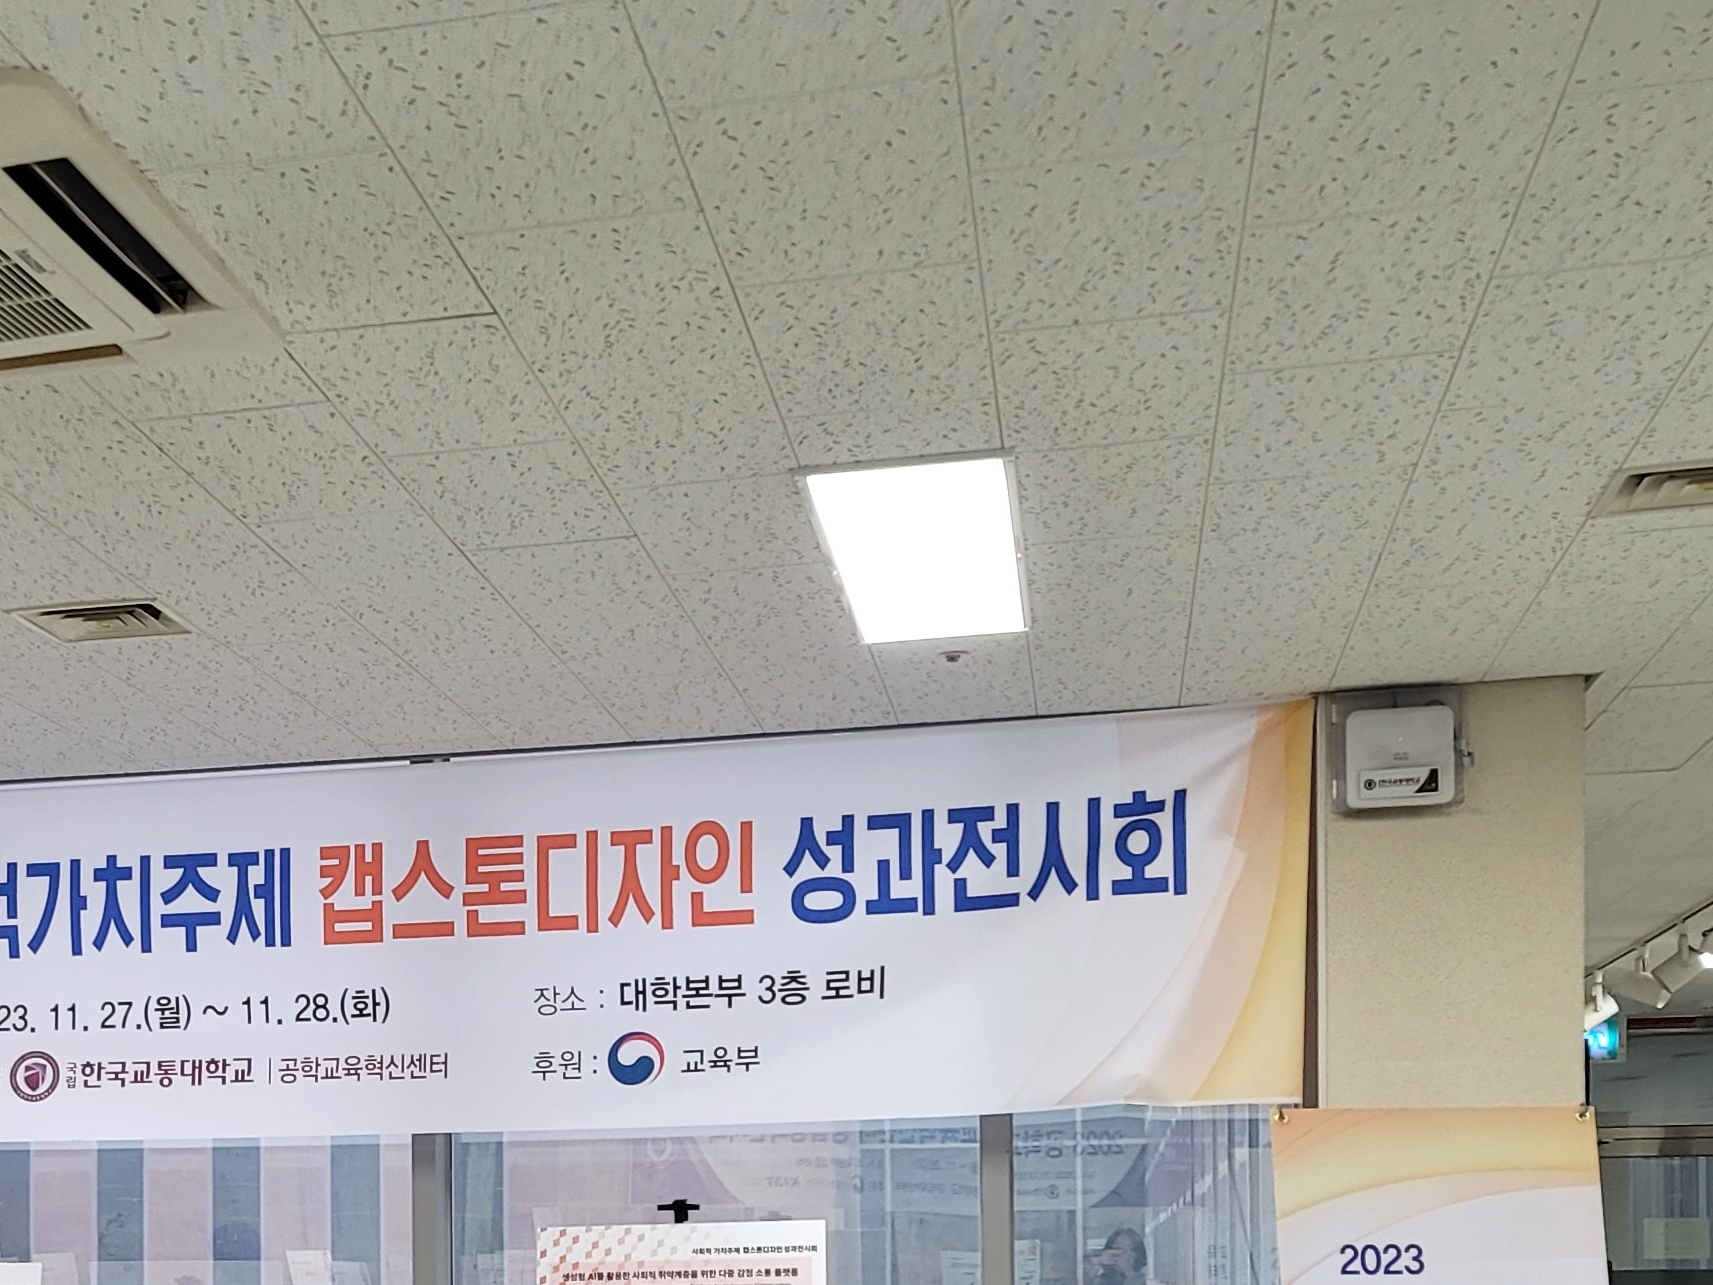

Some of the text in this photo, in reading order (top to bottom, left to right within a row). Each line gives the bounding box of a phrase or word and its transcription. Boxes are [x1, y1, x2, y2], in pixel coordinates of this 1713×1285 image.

[318, 820, 754, 945] 캡스톤디자인
[782, 789, 1188, 925] 성과전시회
[50, 1003, 89, 1031] 11.
[101, 995, 191, 1032] 27.(월)
[241, 996, 283, 1025] 11.
[294, 986, 391, 1024] 28.(화)
[533, 985, 586, 1015] 장소
[619, 973, 747, 1012] 대학본부
[757, 969, 810, 1005] 3층
[821, 965, 886, 1000] 로비
[80, 1058, 255, 1088] 한국교통대학교
[278, 1052, 448, 1084] 공학교육혁신센터
[531, 1050, 582, 1080] 후원
[680, 1045, 761, 1074] 교육부
[1339, 1244, 1425, 1275] 2023
